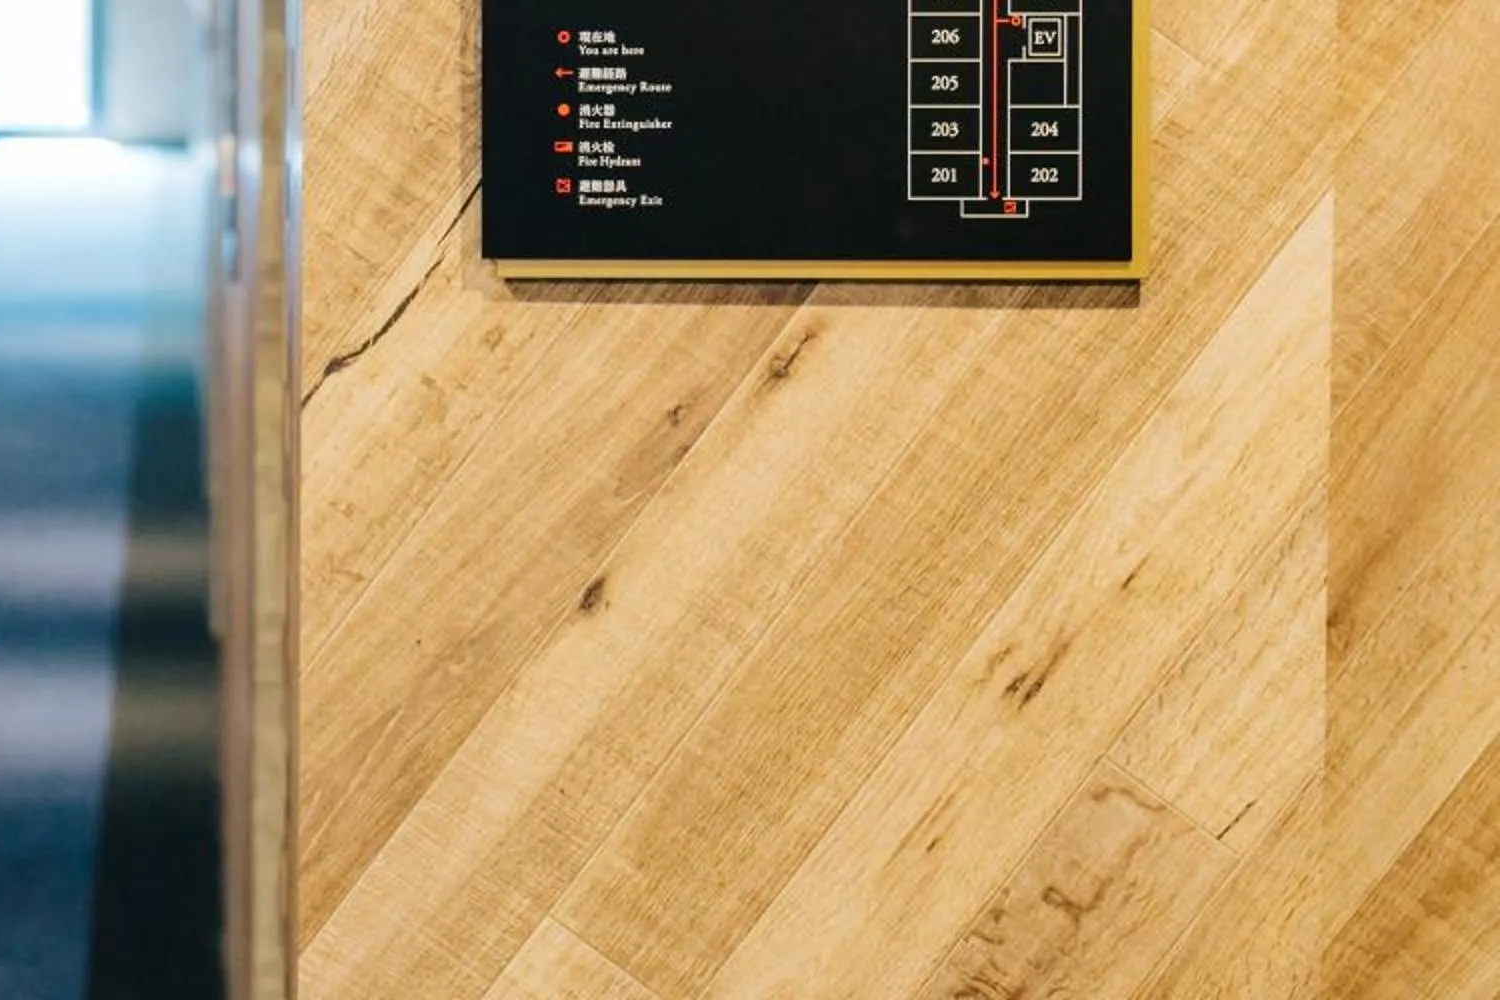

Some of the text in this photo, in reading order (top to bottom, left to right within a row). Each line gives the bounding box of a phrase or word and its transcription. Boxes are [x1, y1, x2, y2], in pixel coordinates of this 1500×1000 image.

[932, 28, 960, 44] 206
[1034, 31, 1057, 45] EV
[579, 45, 599, 55] You
[622, 44, 644, 55] here
[578, 81, 672, 94] Emergency Route
[932, 75, 958, 91] 205
[579, 118, 672, 132] Fire Extinguisher
[932, 122, 959, 137] 203
[1031, 121, 1058, 136] 204
[578, 156, 640, 168] Fire Hydrant
[932, 168, 956, 182] 201
[1031, 168, 1058, 182] 202
[579, 195, 662, 208] Emergency Exit
